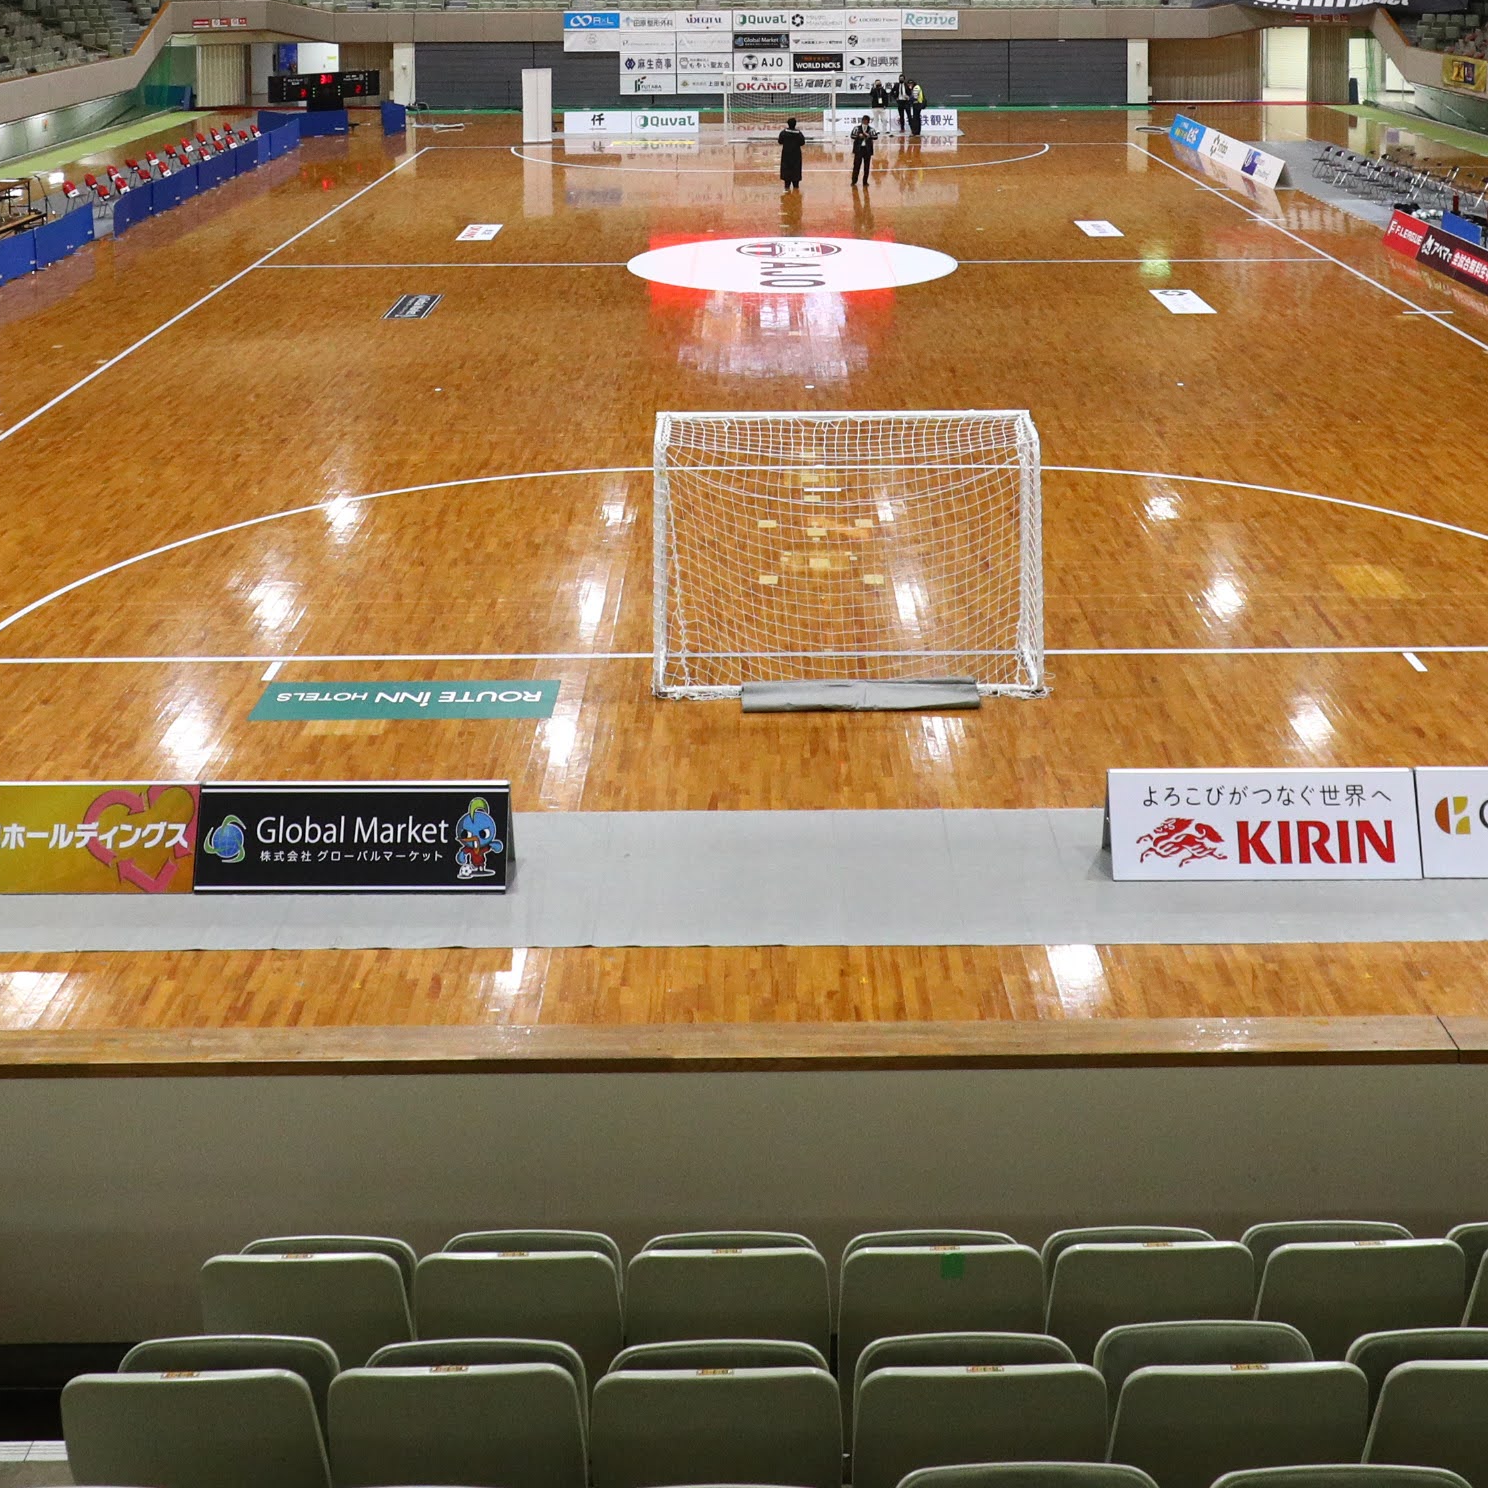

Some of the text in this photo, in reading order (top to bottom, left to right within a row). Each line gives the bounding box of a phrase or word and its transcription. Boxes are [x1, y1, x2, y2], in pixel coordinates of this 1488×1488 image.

[748, 14, 786, 24] Quval
[904, 12, 956, 26] Revive
[638, 58, 672, 70] 麻生商事
[761, 58, 783, 67] AJO
[736, 82, 787, 91] OKANO
[650, 116, 695, 127] Quval
[1396, 225, 1424, 246] F.LEAGUE
[760, 262, 826, 288] AJO
[276, 692, 366, 702] HOTELS
[438, 690, 542, 703] ROUTE
[1144, 784, 1392, 810] よろこびがつなぐ世界へ
[257, 816, 449, 846] Global Market
[1237, 820, 1396, 864] KIRIN
[260, 850, 444, 863] 株式会社 グローバルマーケット
